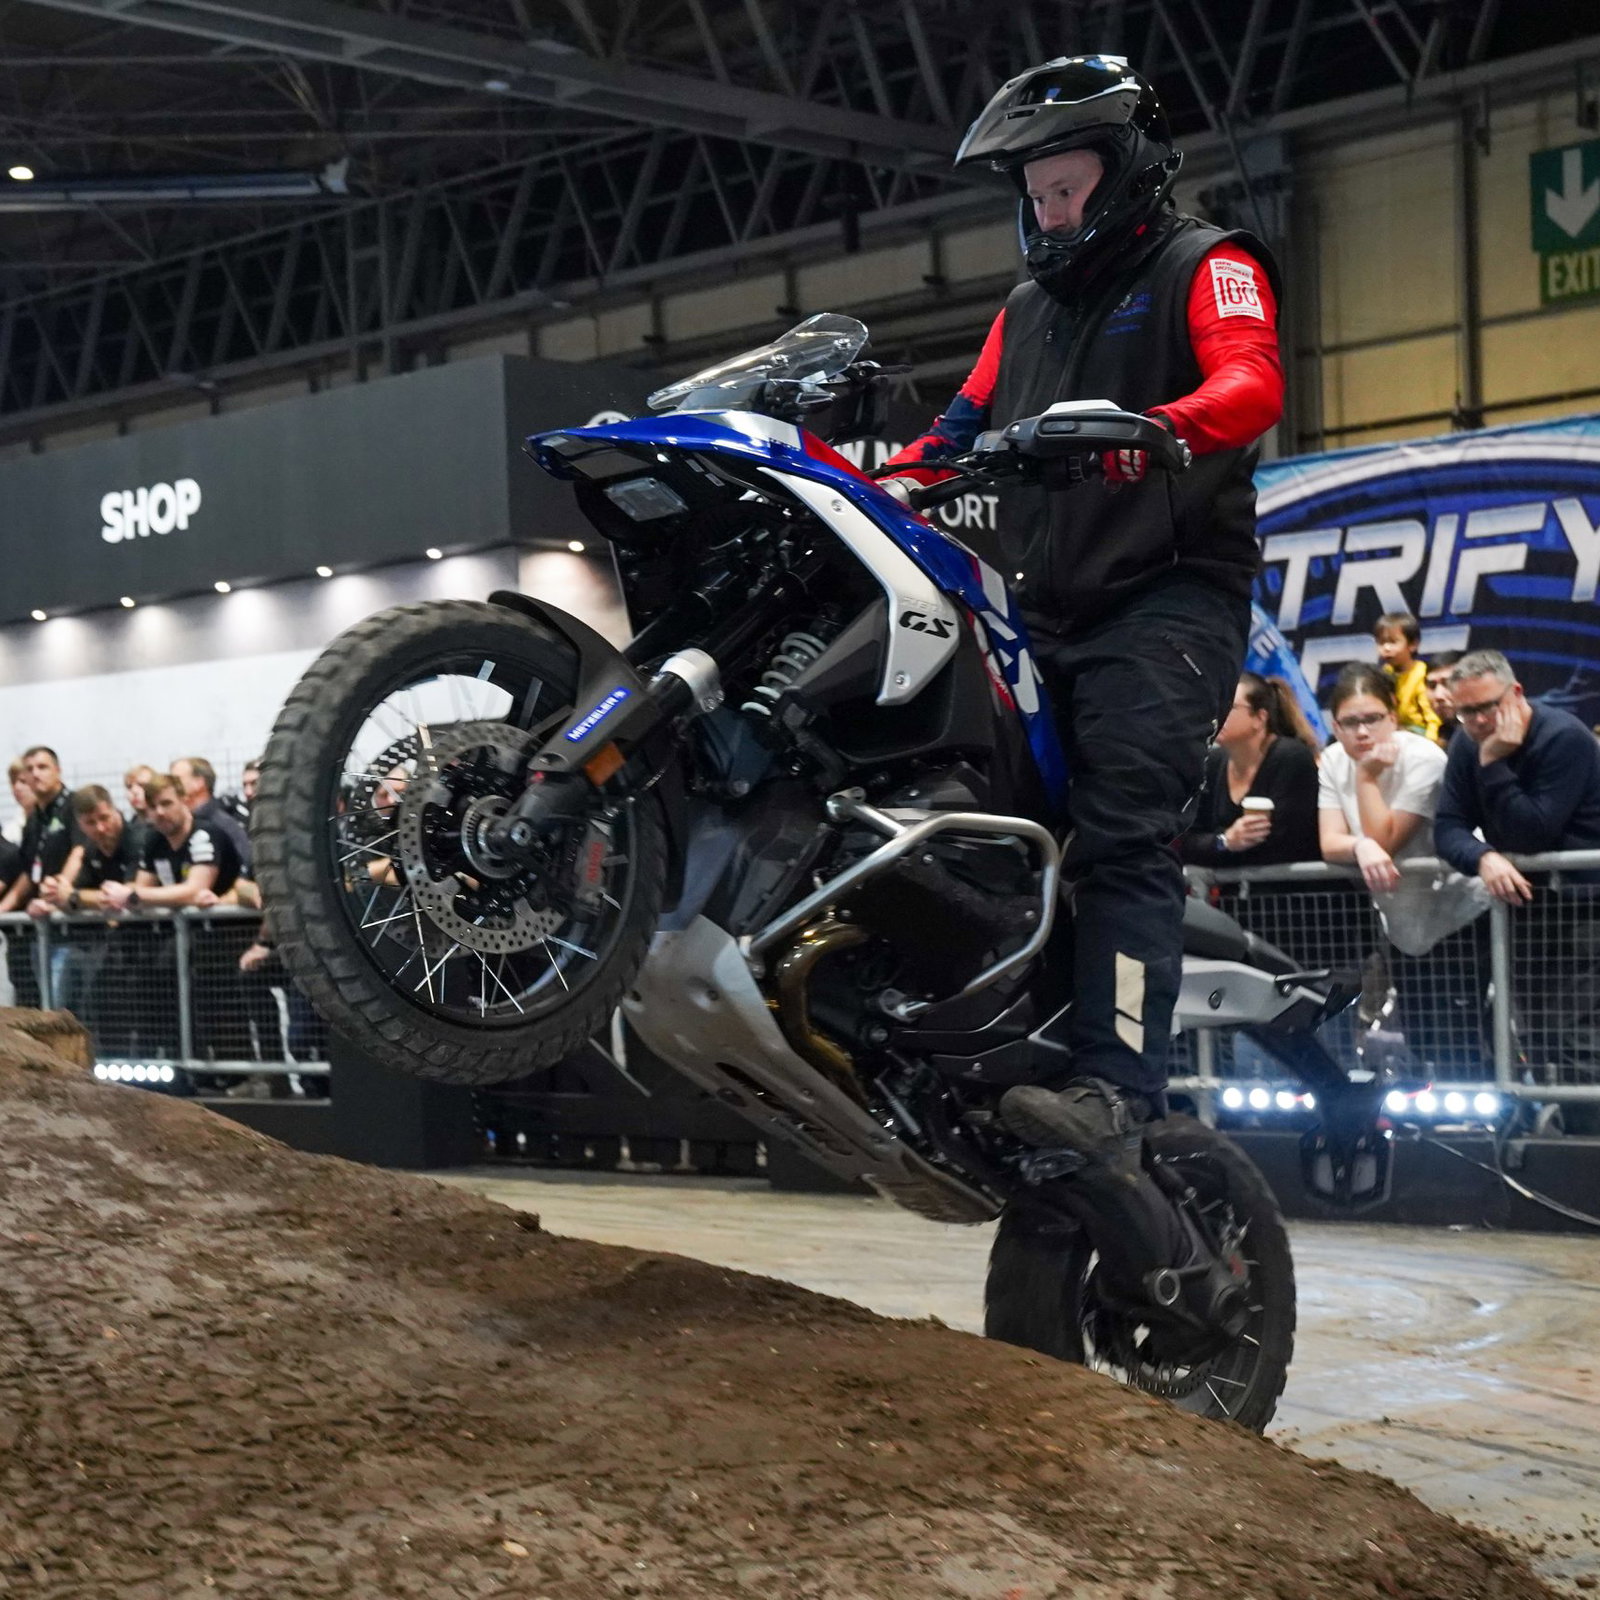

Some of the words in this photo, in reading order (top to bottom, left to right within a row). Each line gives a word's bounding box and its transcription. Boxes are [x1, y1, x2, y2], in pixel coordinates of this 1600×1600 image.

[1216, 276, 1258, 306] 100
[101, 478, 202, 544] SHOP
[922, 493, 999, 530] ORT
[1256, 498, 1600, 632] TRIFY
[899, 610, 954, 639] GS
[567, 696, 619, 740] METZELER
